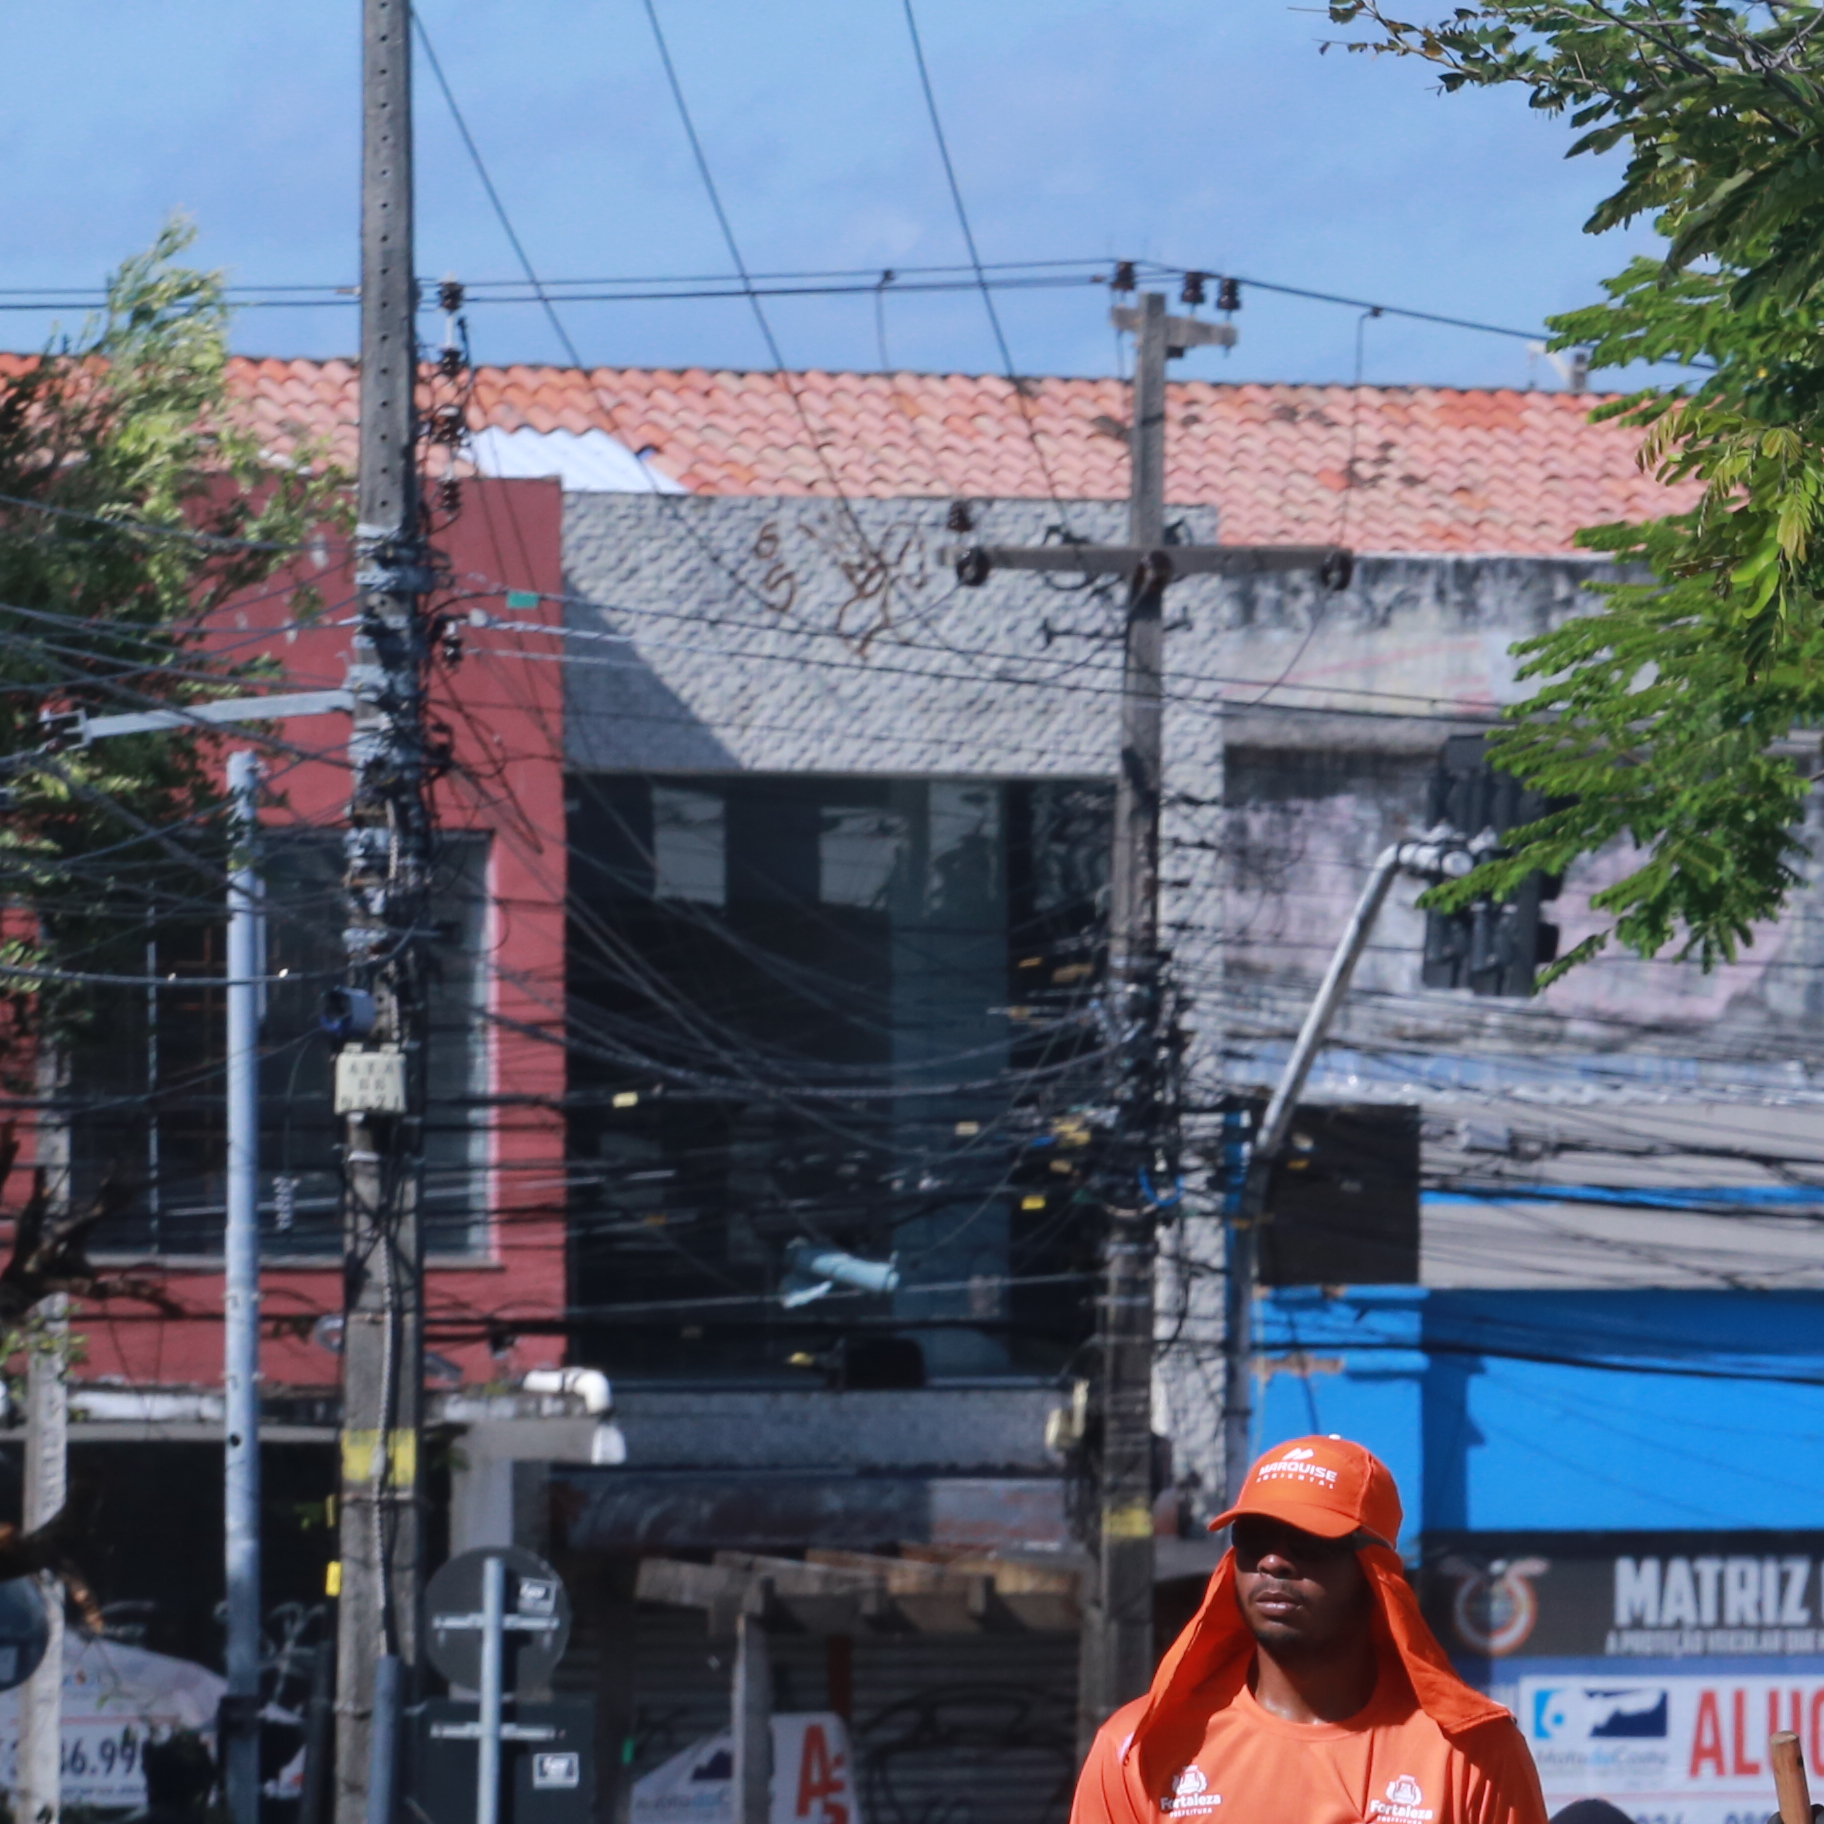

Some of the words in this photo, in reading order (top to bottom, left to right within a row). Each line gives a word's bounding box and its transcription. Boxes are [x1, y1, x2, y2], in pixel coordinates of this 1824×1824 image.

[1258, 1461, 1338, 1483] MARQUISE
[1614, 1555, 1811, 1628] MATRIZ
[1160, 1792, 1222, 1811] Fortaleza
[1370, 1799, 1434, 1821] Fortaleza
